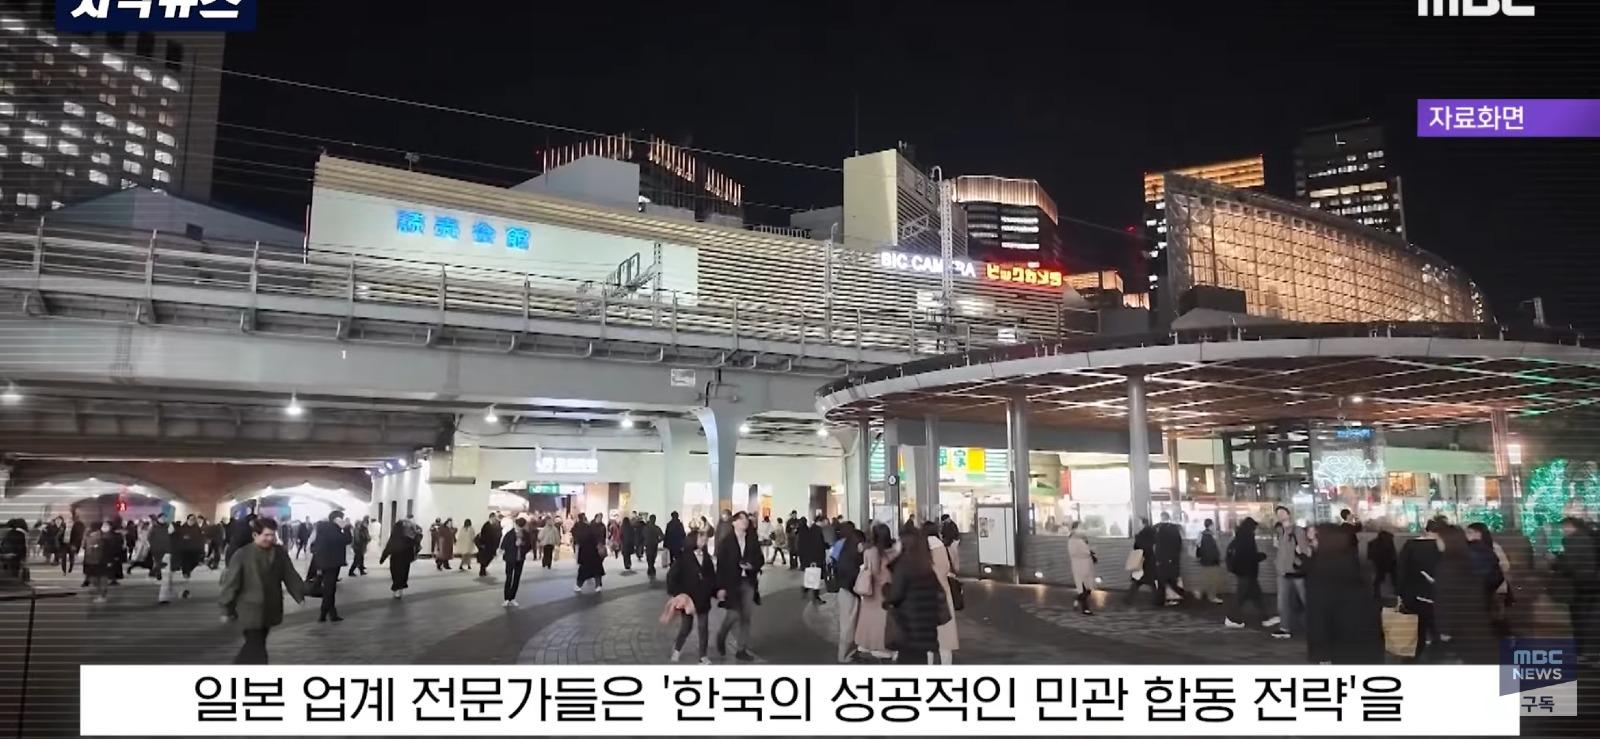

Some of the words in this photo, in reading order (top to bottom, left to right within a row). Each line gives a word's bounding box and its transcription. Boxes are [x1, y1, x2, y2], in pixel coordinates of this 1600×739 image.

[880, 251, 908, 269] BIC
[911, 254, 977, 279] CAMRA
[986, 263, 1063, 287] ビックカメラ
